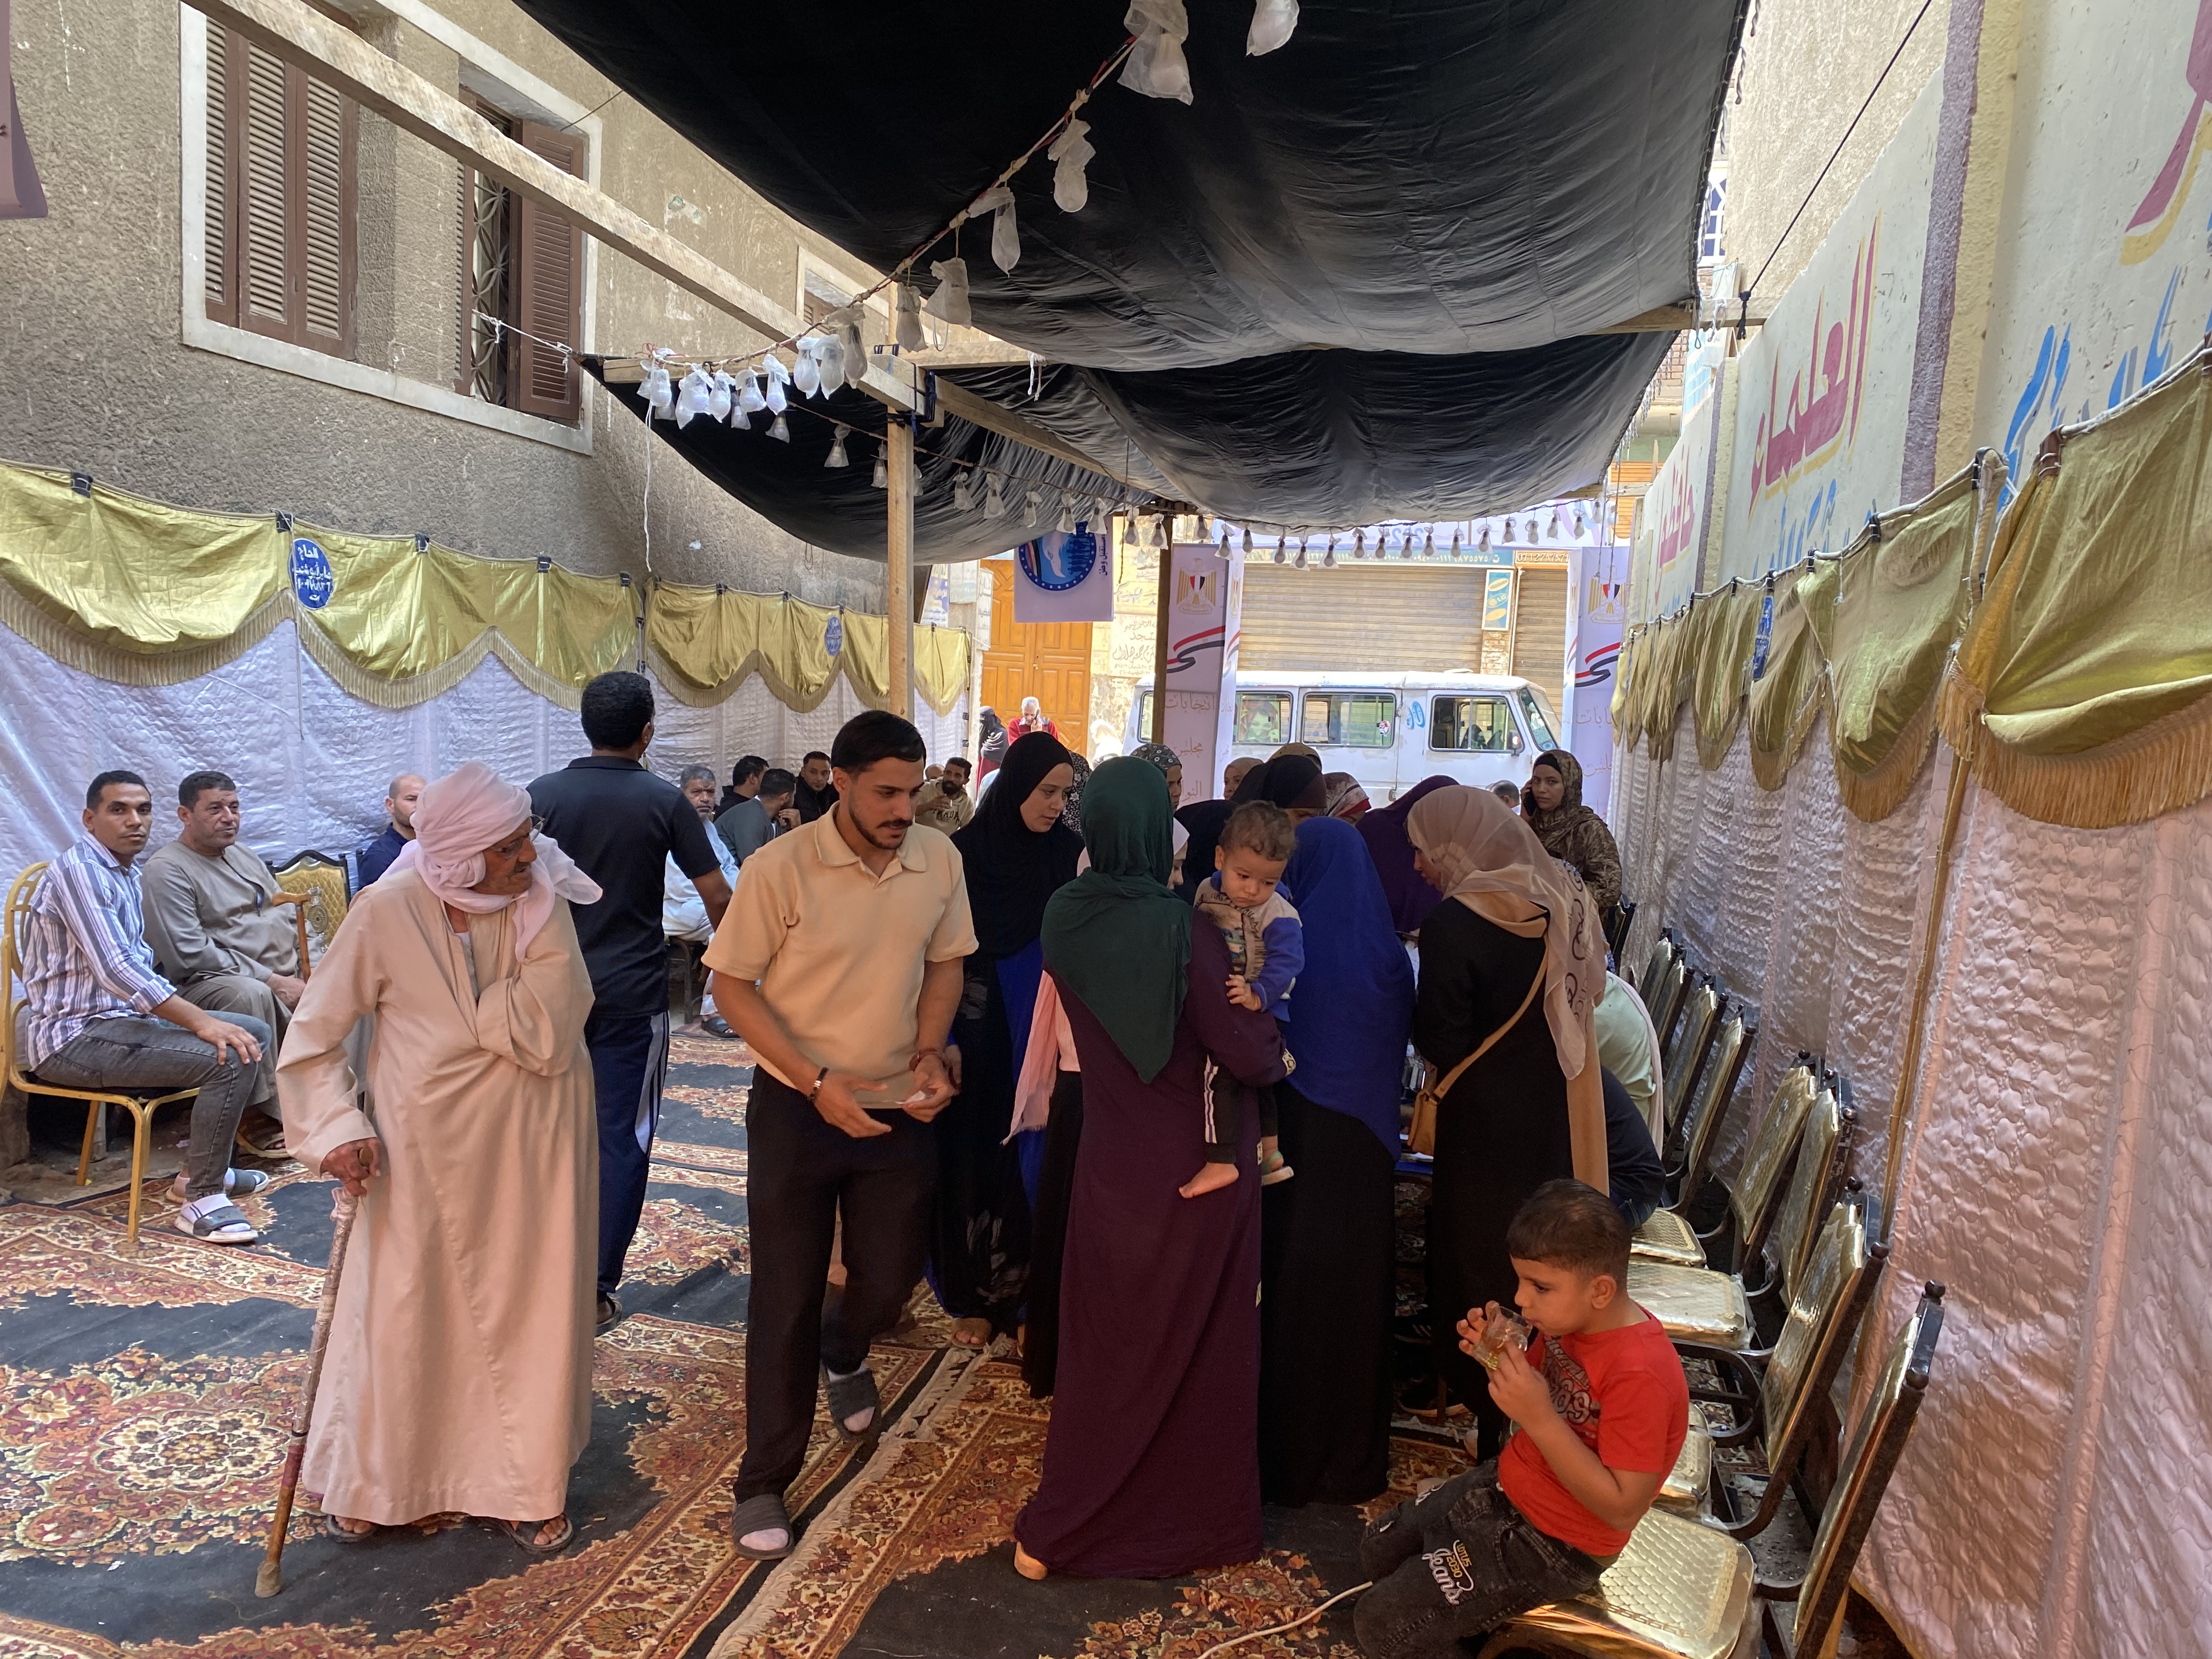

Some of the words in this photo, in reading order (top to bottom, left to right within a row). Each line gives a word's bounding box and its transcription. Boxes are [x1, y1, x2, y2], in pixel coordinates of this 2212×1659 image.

[1165, 691, 1215, 714] انتخابات
[1177, 737, 1204, 758] مجلس
[1457, 1542, 1472, 1567] LOTUS
[1446, 1555, 1463, 1578] 2030
